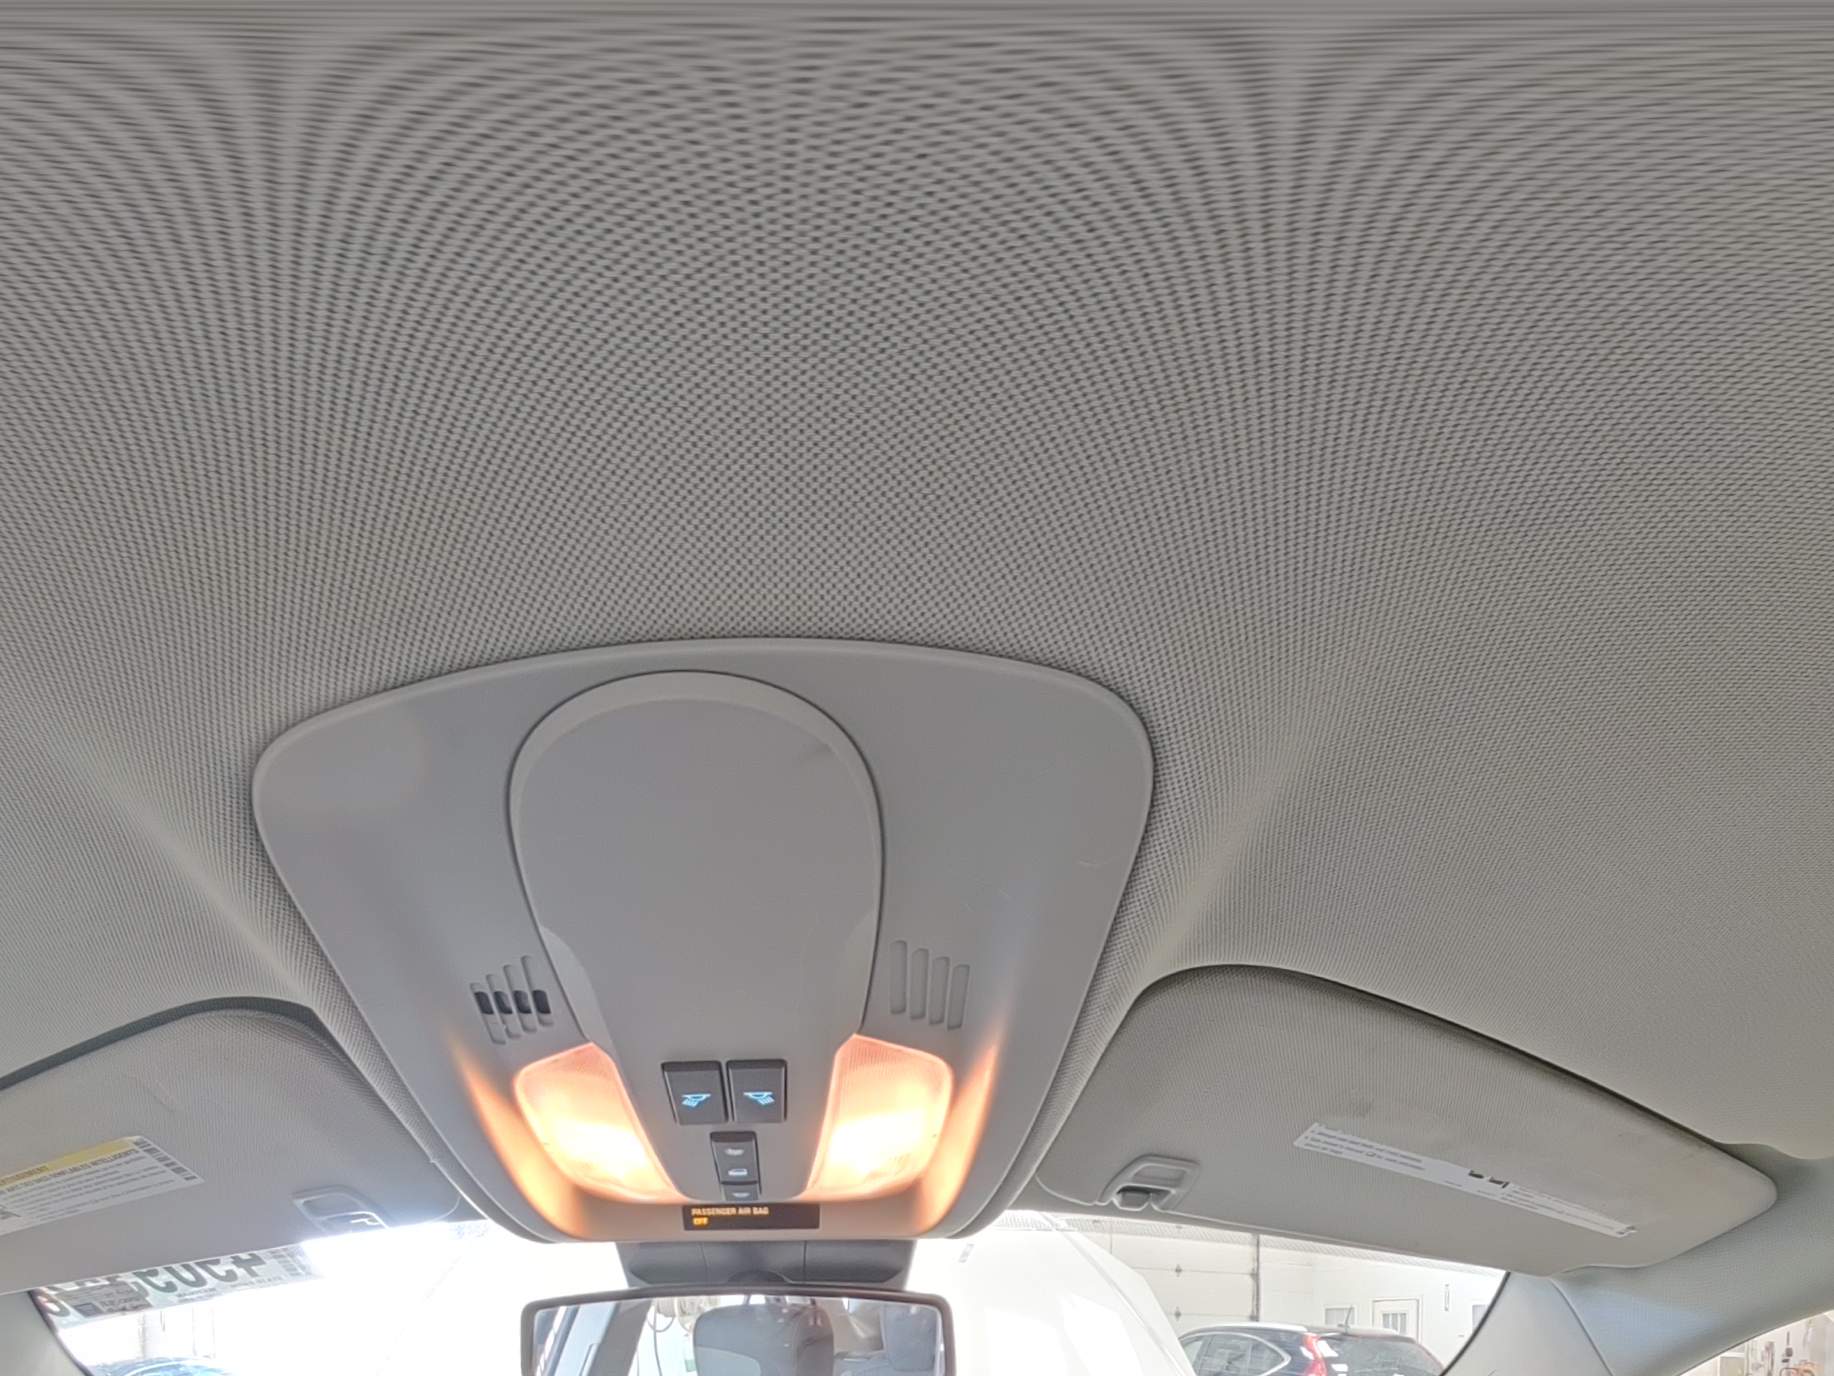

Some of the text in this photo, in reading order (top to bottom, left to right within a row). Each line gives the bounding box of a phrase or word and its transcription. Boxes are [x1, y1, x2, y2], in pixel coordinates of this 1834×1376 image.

[691, 1206, 769, 1216] PASSENGER AIR BAG
